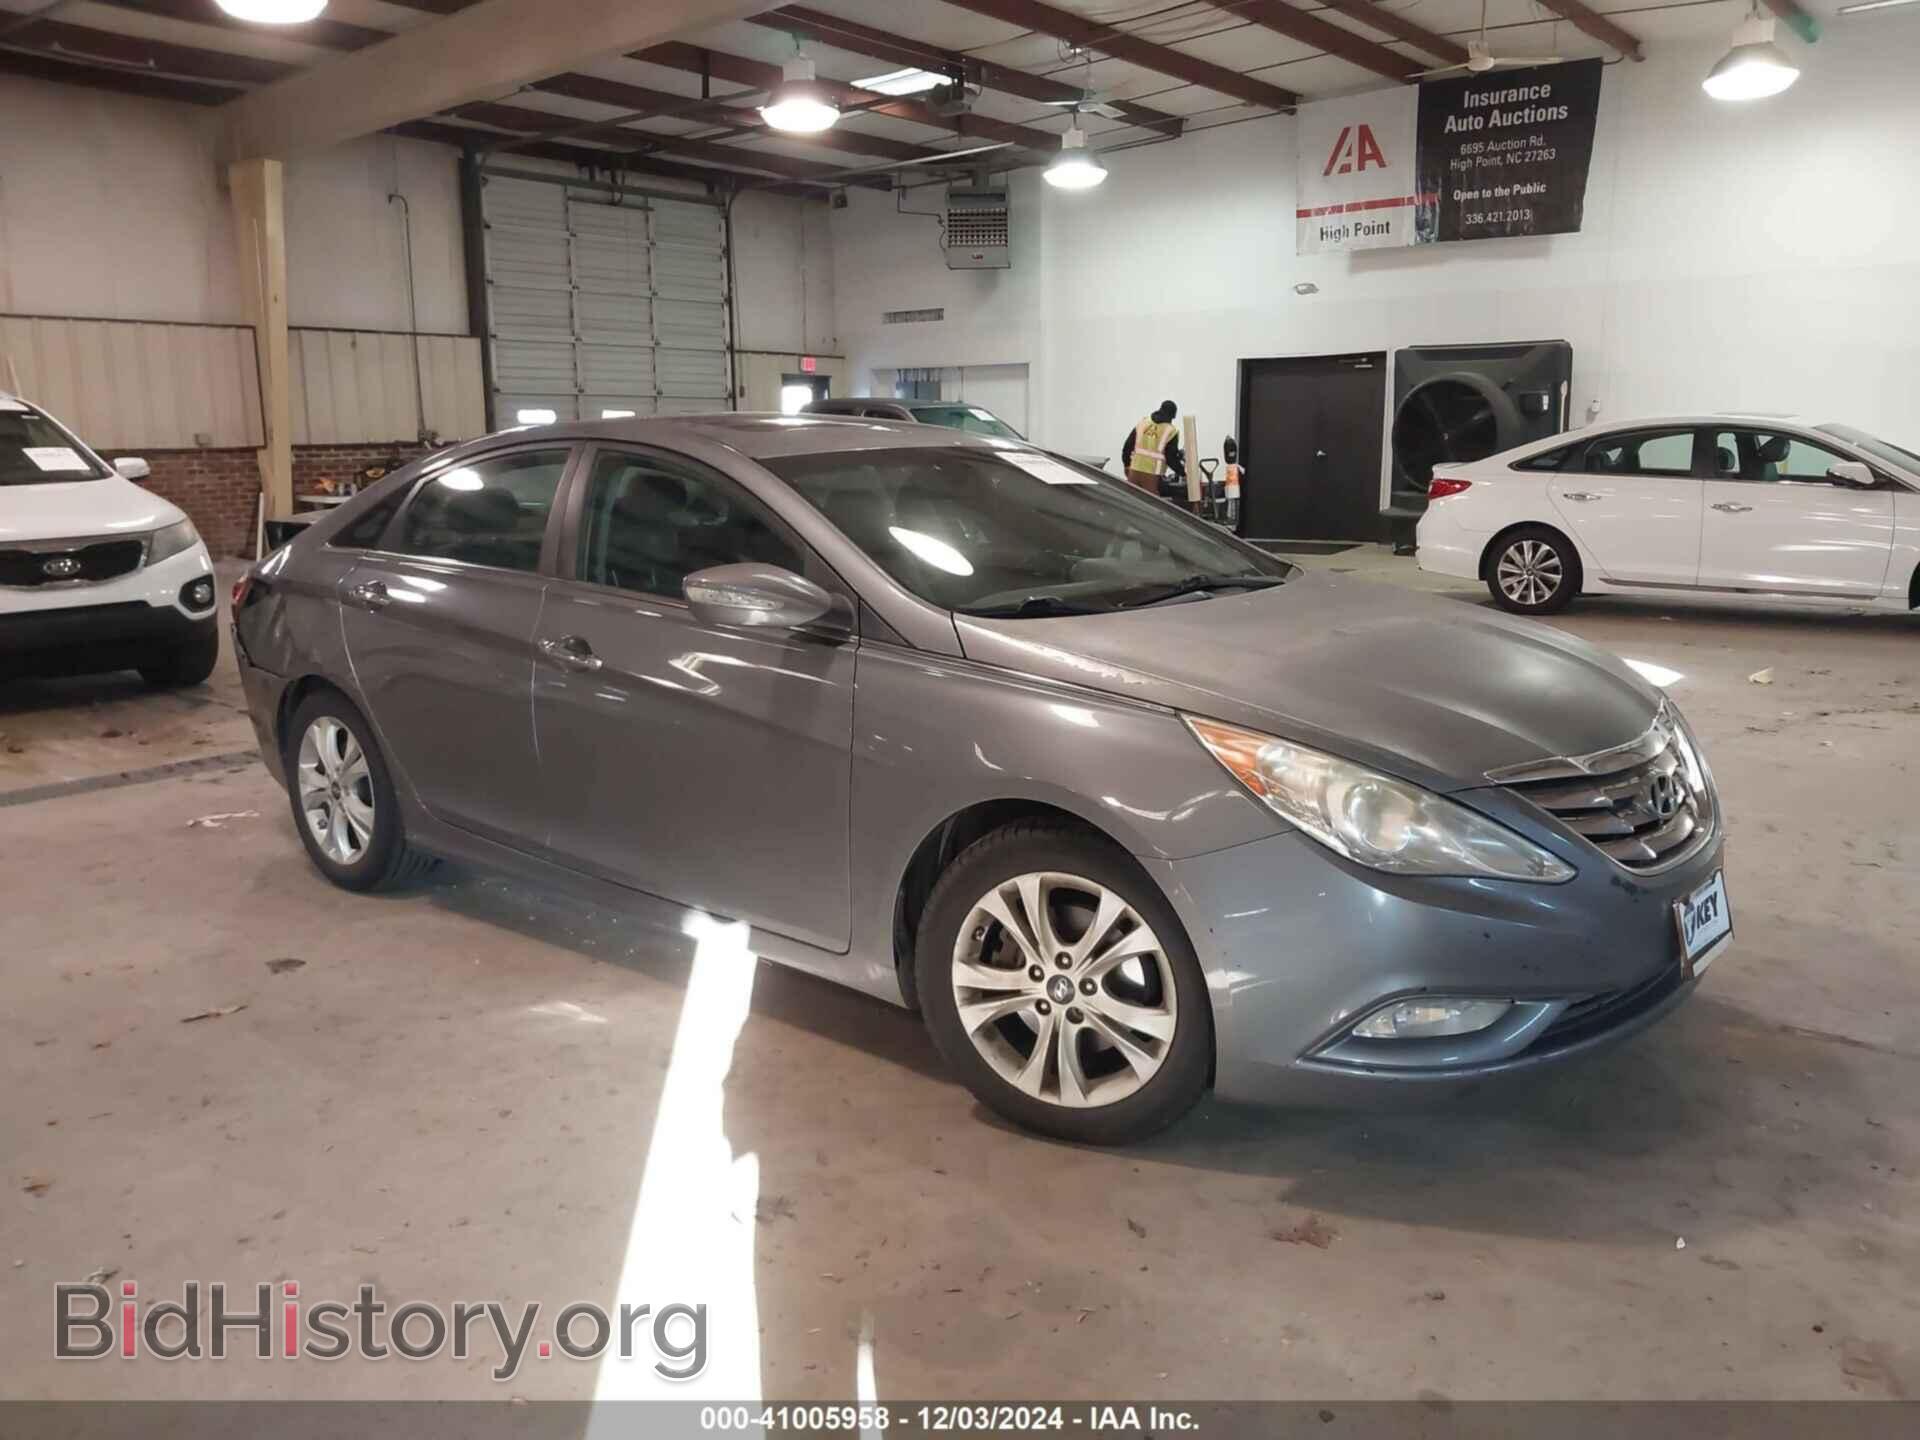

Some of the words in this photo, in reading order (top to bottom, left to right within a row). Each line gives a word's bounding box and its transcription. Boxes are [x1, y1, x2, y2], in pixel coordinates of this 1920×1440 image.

[1464, 84, 1551, 108] Insurance
[1444, 114, 1484, 134] Auto
[1488, 104, 1569, 128] Auctions
[1487, 138, 1527, 152] Auction
[1529, 133, 1546, 147] Rd.
[1450, 157, 1473, 171] High
[1506, 152, 1522, 164] NC
[1524, 148, 1556, 162] 27263
[1453, 189, 1479, 202] Open
[1482, 189, 1492, 198] to
[1494, 186, 1510, 197] the
[1512, 182, 1547, 195] Public
[1320, 224, 1350, 243] High
[1354, 220, 1391, 237] Point
[1696, 890, 1718, 929] KEY
